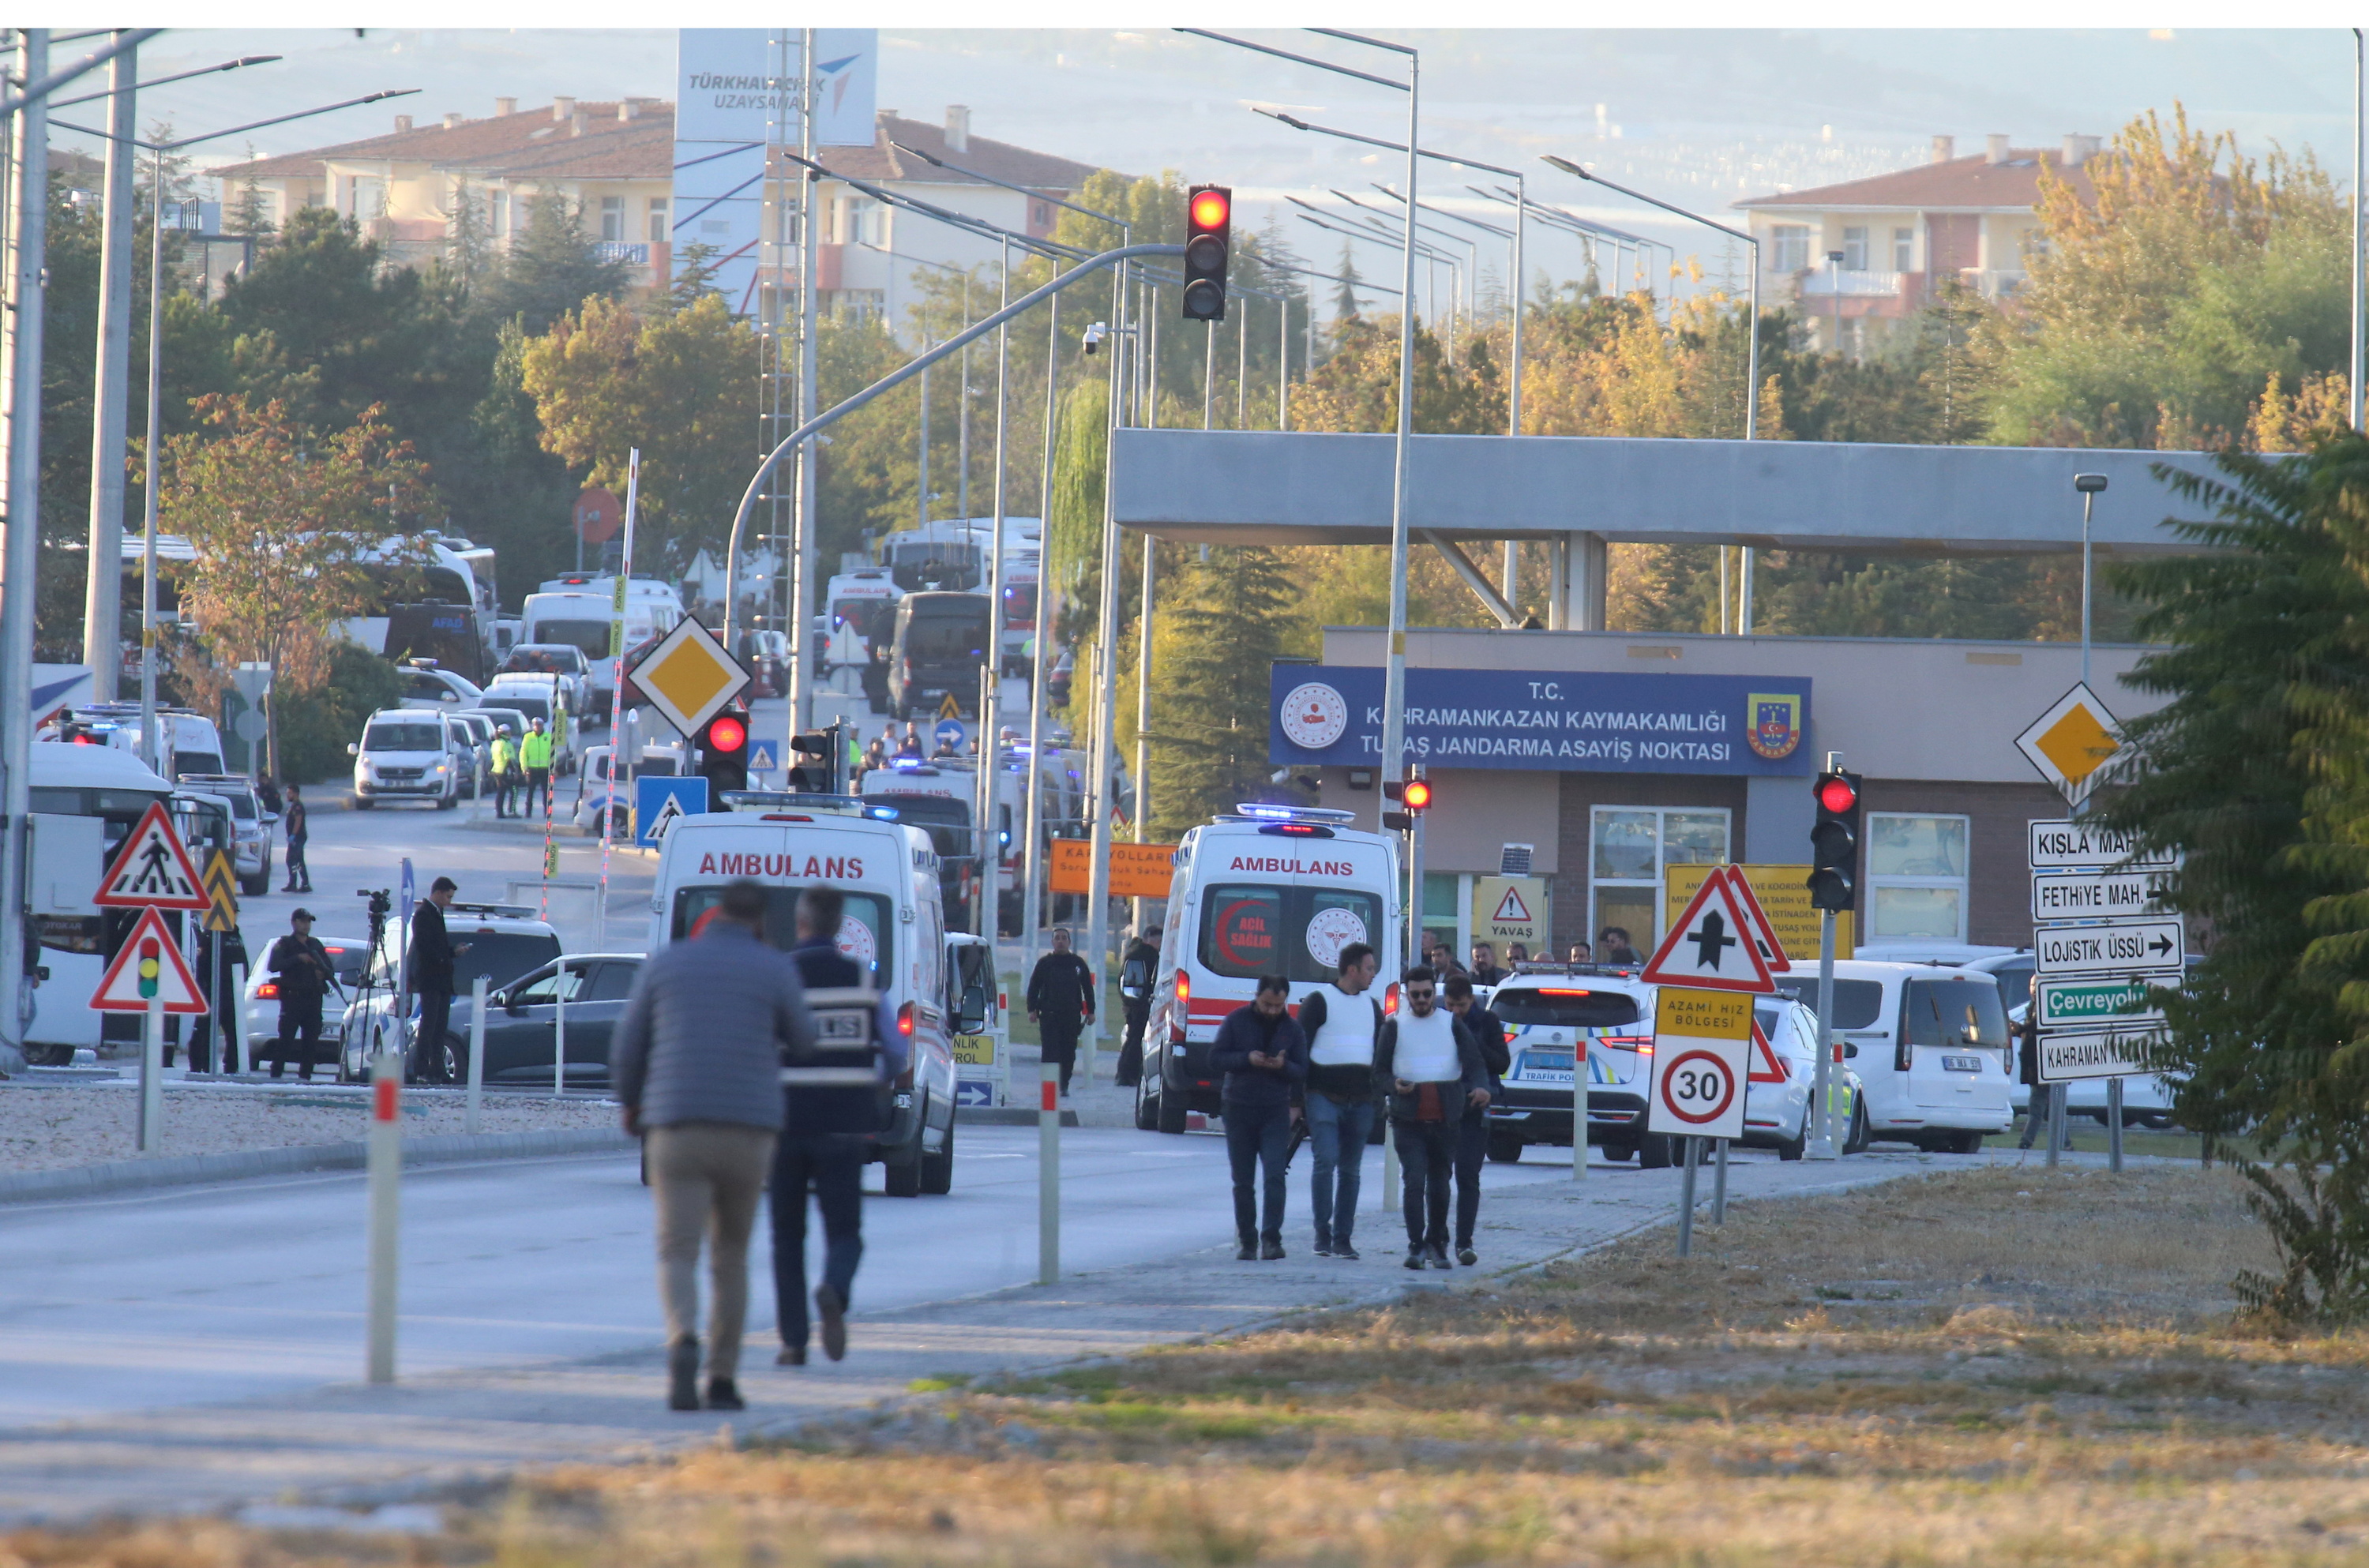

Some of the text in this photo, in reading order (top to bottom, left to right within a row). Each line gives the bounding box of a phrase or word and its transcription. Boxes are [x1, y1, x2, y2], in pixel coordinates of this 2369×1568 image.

[1528, 681, 1564, 700] T.C.
[1366, 707, 1725, 732] KHRAMANKAZAN KAYMAKAMLIĞI
[1361, 736, 1730, 763] TUAŞ JANDARMA ASAYİŞ NOKTASI
[2038, 833, 2090, 858] KIŞLA
[698, 851, 863, 880] AMBULANS
[1229, 856, 1353, 876] AMBULANS
[1767, 882, 1808, 891] KOORDİN
[1770, 895, 1794, 904] TARİH
[2042, 883, 2144, 907] FETHİYE MAH.
[1772, 910, 1815, 918] İSTİNADEN
[1239, 916, 1266, 932] ACİL
[1491, 925, 1533, 939] YAVAŞ
[1773, 924, 1800, 933] TUSAŞ
[1230, 932, 1272, 948] SAĞLIK
[2044, 932, 2145, 963] LOJİSTİK ÜSSÜ
[1667, 1000, 1744, 1015] AZAMİ HIZ
[1675, 1013, 1734, 1029] BÖLGESİ
[953, 1035, 979, 1049] NLİK
[2048, 1043, 2108, 1068] KAHRAMAN
[1526, 1071, 1556, 1080] TRAFİK
[1678, 1070, 1718, 1101] 30
